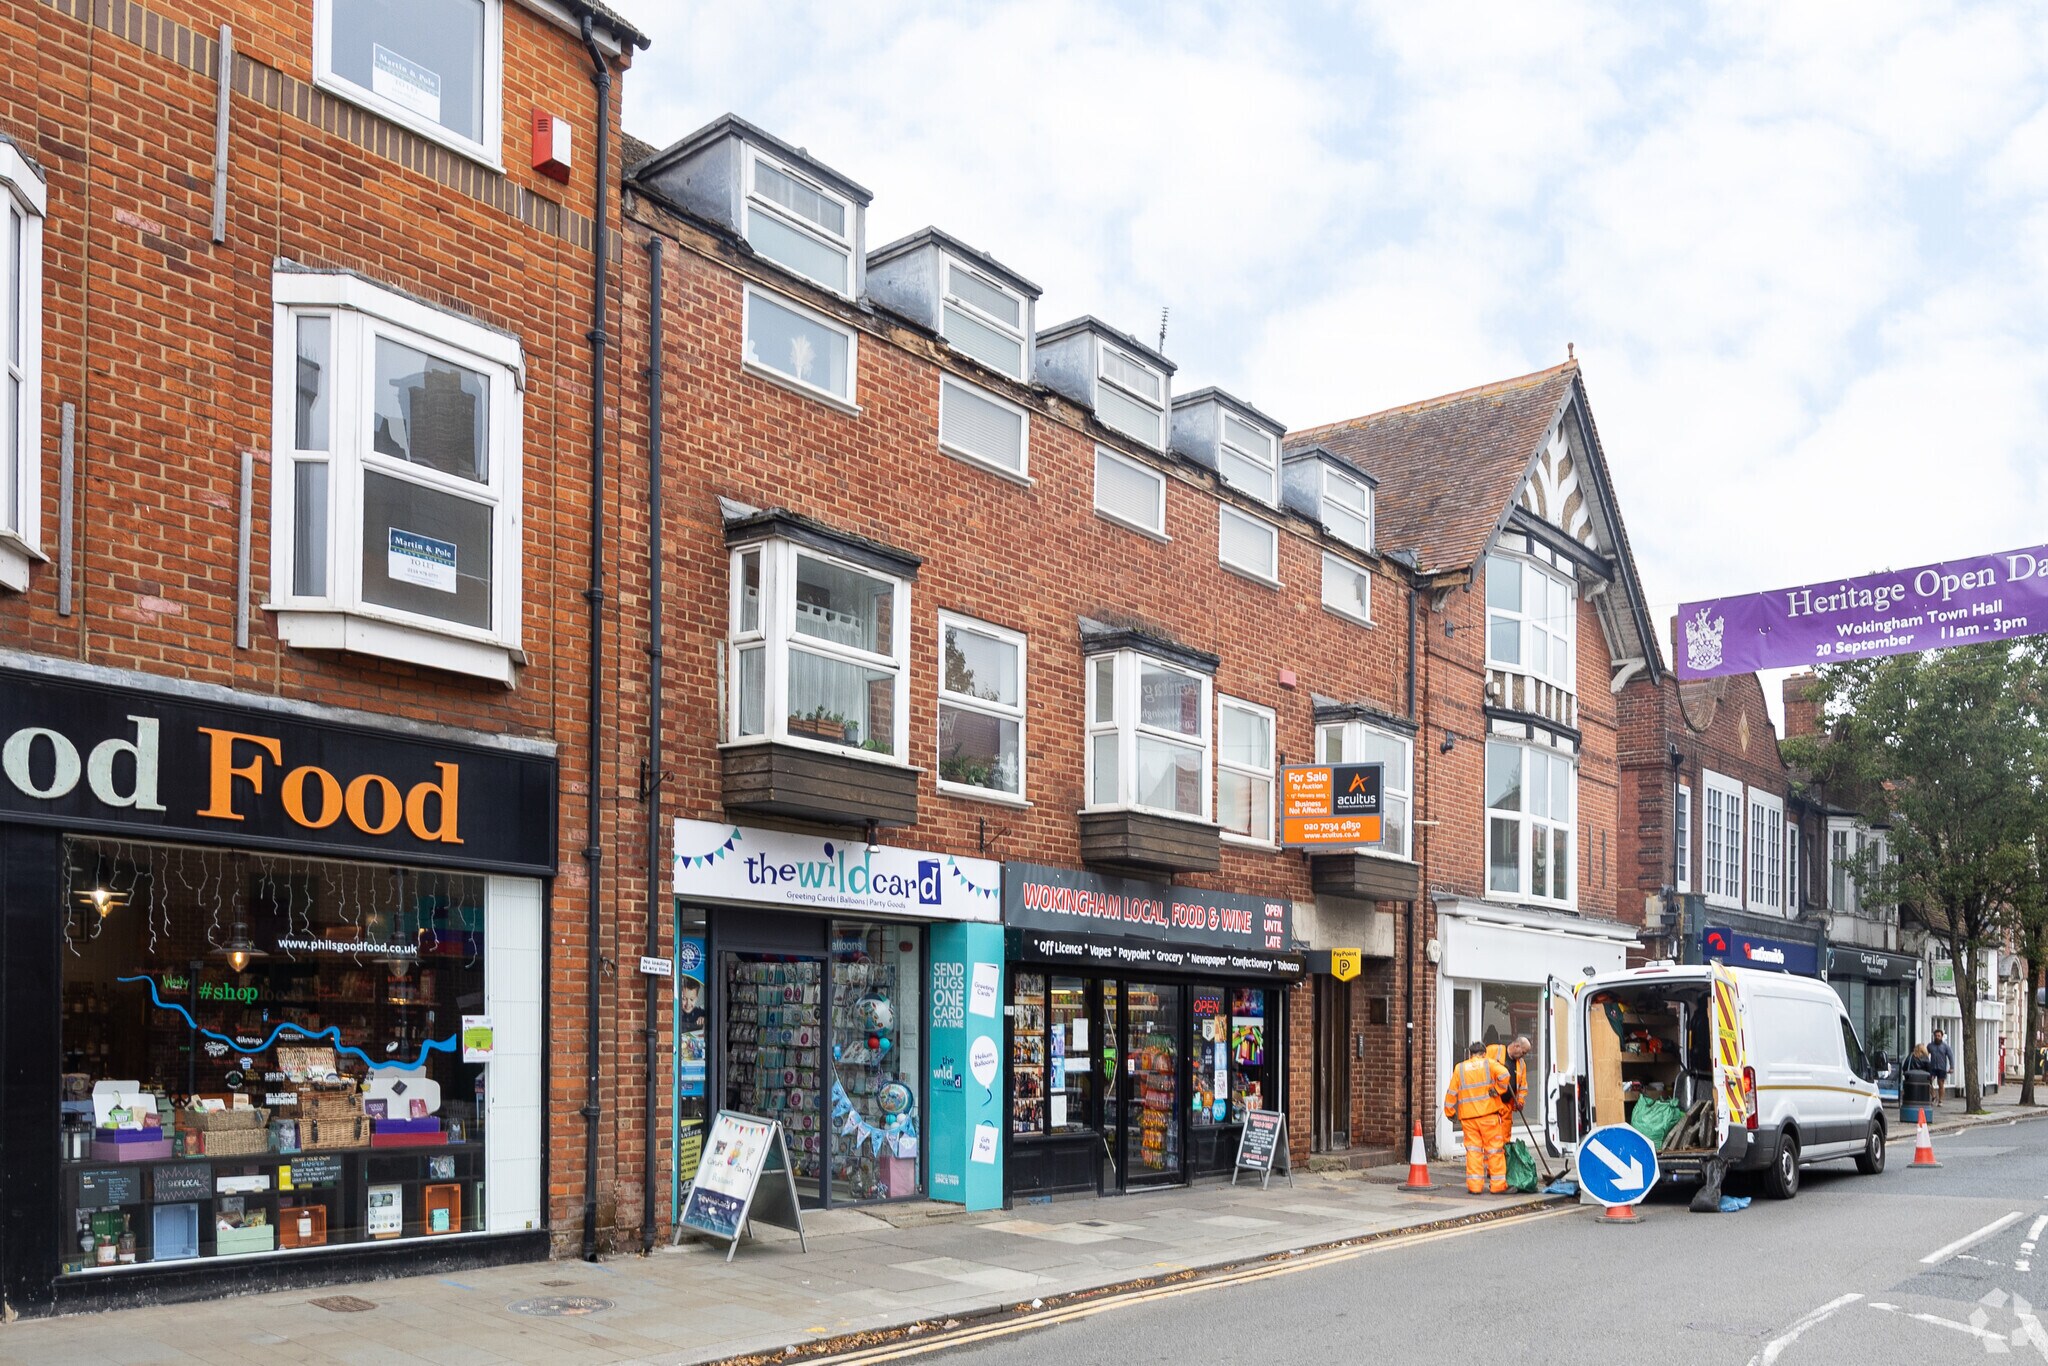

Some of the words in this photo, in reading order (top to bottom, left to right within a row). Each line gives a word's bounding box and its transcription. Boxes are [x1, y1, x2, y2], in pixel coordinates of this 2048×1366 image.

[395, 536, 423, 550] Martin
[426, 545, 432, 553] &
[435, 546, 452, 558] Pole
[411, 558, 421, 566] TO
[422, 561, 435, 570] LET
[1786, 582, 1905, 618] Heritage
[1914, 567, 1996, 602] Open
[1836, 615, 1923, 637] Wokingham
[1927, 608, 1968, 624] Town
[1972, 599, 2003, 617] Hall
[1941, 623, 1979, 638] 11am
[1993, 615, 2028, 634] 3pm
[1816, 644, 1831, 656] 20
[1835, 634, 1914, 655] September
[1288, 772, 1304, 783] For
[1306, 772, 1328, 782] Sale
[197, 726, 464, 844] Food
[1337, 793, 1376, 805] acuitus
[1302, 806, 1328, 814] Affected
[1303, 823, 1319, 831] 020
[1320, 823, 1339, 831] 7034
[1340, 820, 1361, 831] 4850
[786, 891, 816, 902] Greeting
[817, 893, 836, 903] Cards
[840, 896, 866, 905] Balloons
[869, 899, 886, 908] Party
[1023, 882, 1121, 920] WOKINGHAM
[1123, 896, 1170, 929] LOCAL,
[1172, 902, 1206, 929] FOOD
[1208, 906, 1219, 931] &
[1221, 907, 1252, 934] WINE
[1265, 903, 1283, 918] OPEN
[1264, 920, 1283, 933] UNTIL
[278, 938, 418, 954] www.philsgoodfood.co.uk
[832, 940, 862, 951] alloons
[1265, 935, 1281, 949] LATE
[1040, 941, 1055, 956] Off
[1055, 942, 1083, 955] Licence
[1090, 945, 1112, 959] Vapes
[1118, 947, 1150, 961] Paypoint
[1156, 951, 1184, 965] Grocery
[1191, 953, 1227, 967] Newspaper
[1232, 956, 1273, 972] Confectionery
[1277, 961, 1300, 971] Tobacco
[933, 962, 964, 976] SEND
[933, 977, 964, 990] HUGS
[974, 981, 995, 993] Greeting
[933, 990, 964, 1007] ONE
[977, 989, 991, 997] Cards
[933, 1006, 964, 1019] CARD
[1193, 1000, 1220, 1013] OPEN
[933, 1019, 942, 1028] AT
[942, 1019, 948, 1028] A
[948, 1019, 964, 1028] TIME
[942, 1056, 954, 1065] the
[975, 1052, 993, 1060] Helium
[974, 1059, 995, 1068] Balloons
[933, 1064, 953, 1079] wild
[942, 1074, 961, 1088] card
[681, 1129, 701, 1138] ANSFER
[979, 1143, 990, 1151] Bags
